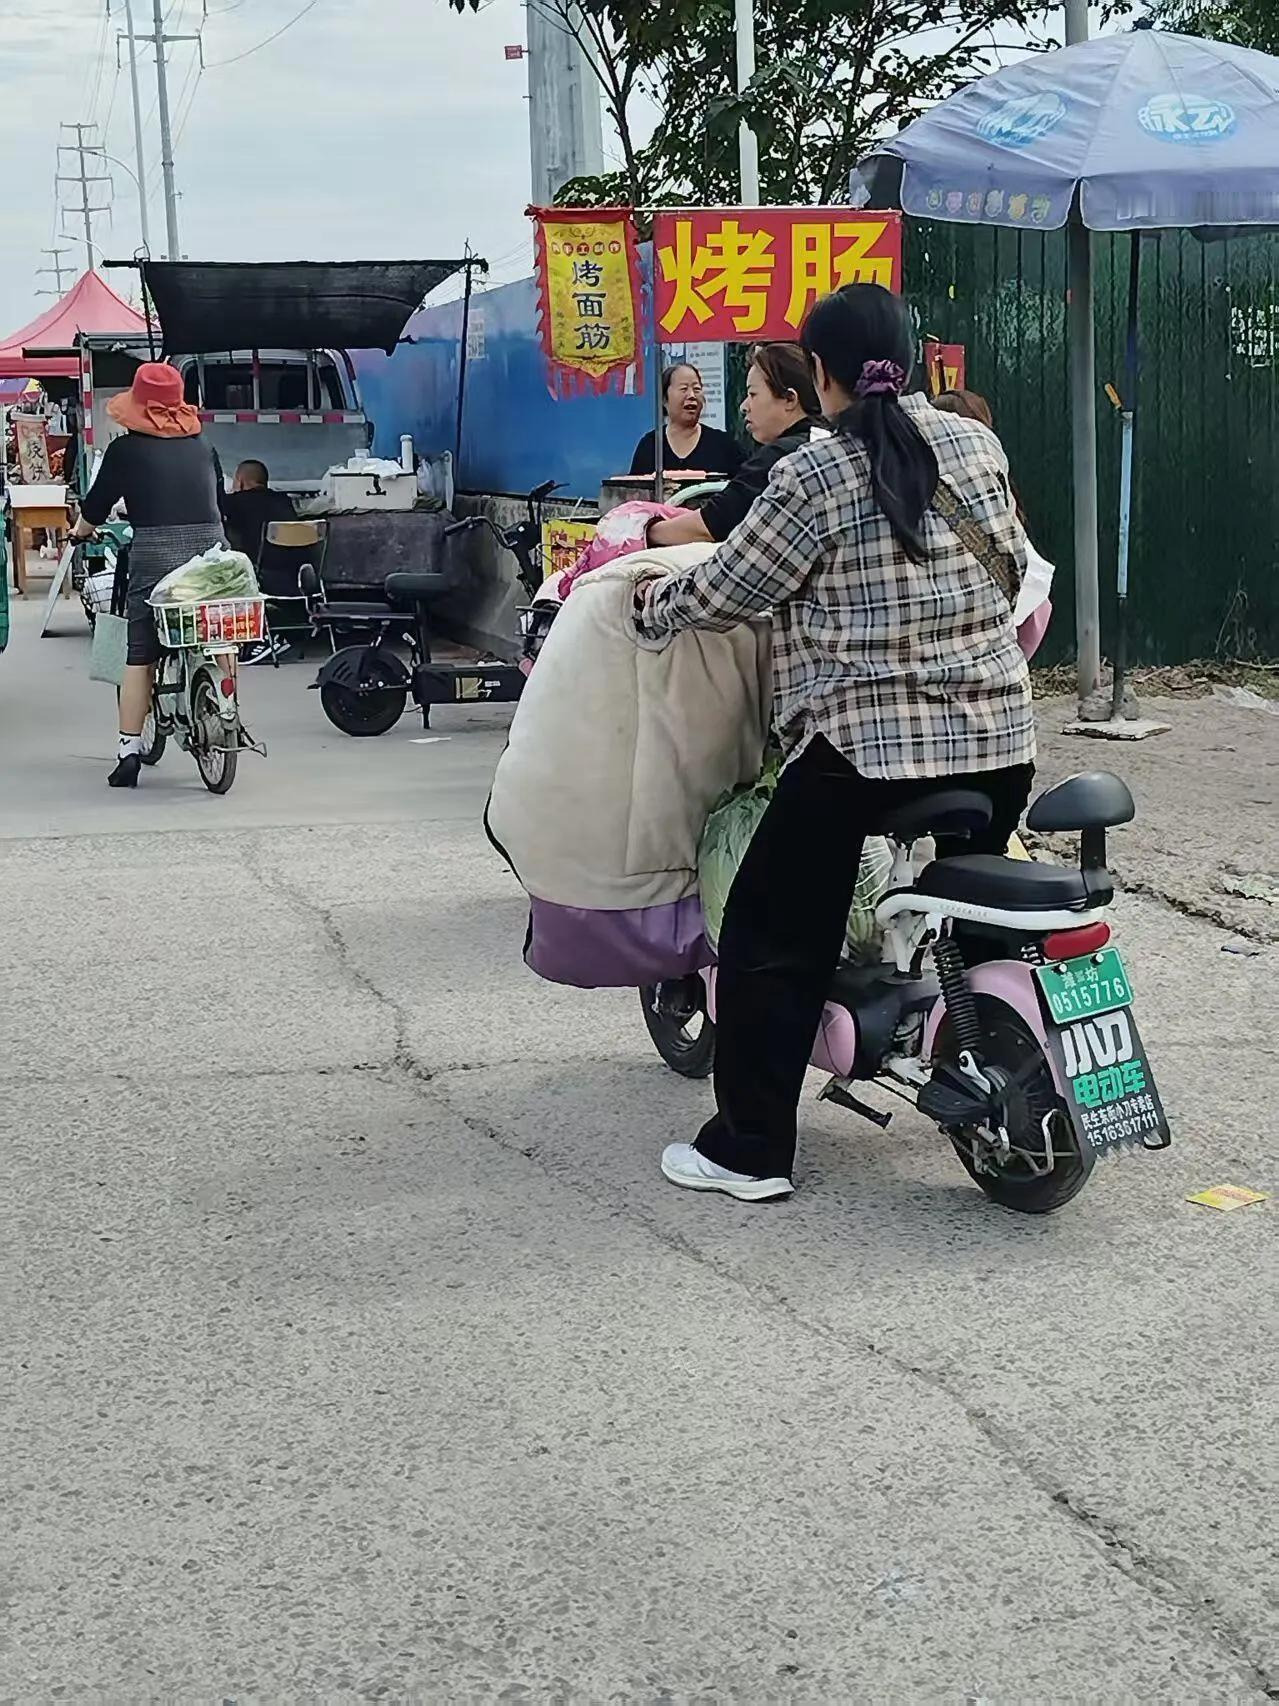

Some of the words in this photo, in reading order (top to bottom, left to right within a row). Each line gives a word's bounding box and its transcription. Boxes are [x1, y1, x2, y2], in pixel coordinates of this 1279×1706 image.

[571, 259, 611, 350] 烤面筋
[657, 220, 893, 334] 烤肠
[1052, 977, 1125, 1014] 0515776
[1060, 1010, 1133, 1078] 小刀
[1072, 1059, 1146, 1109] 电动车
[1086, 1110, 1159, 1147] 15163617111
